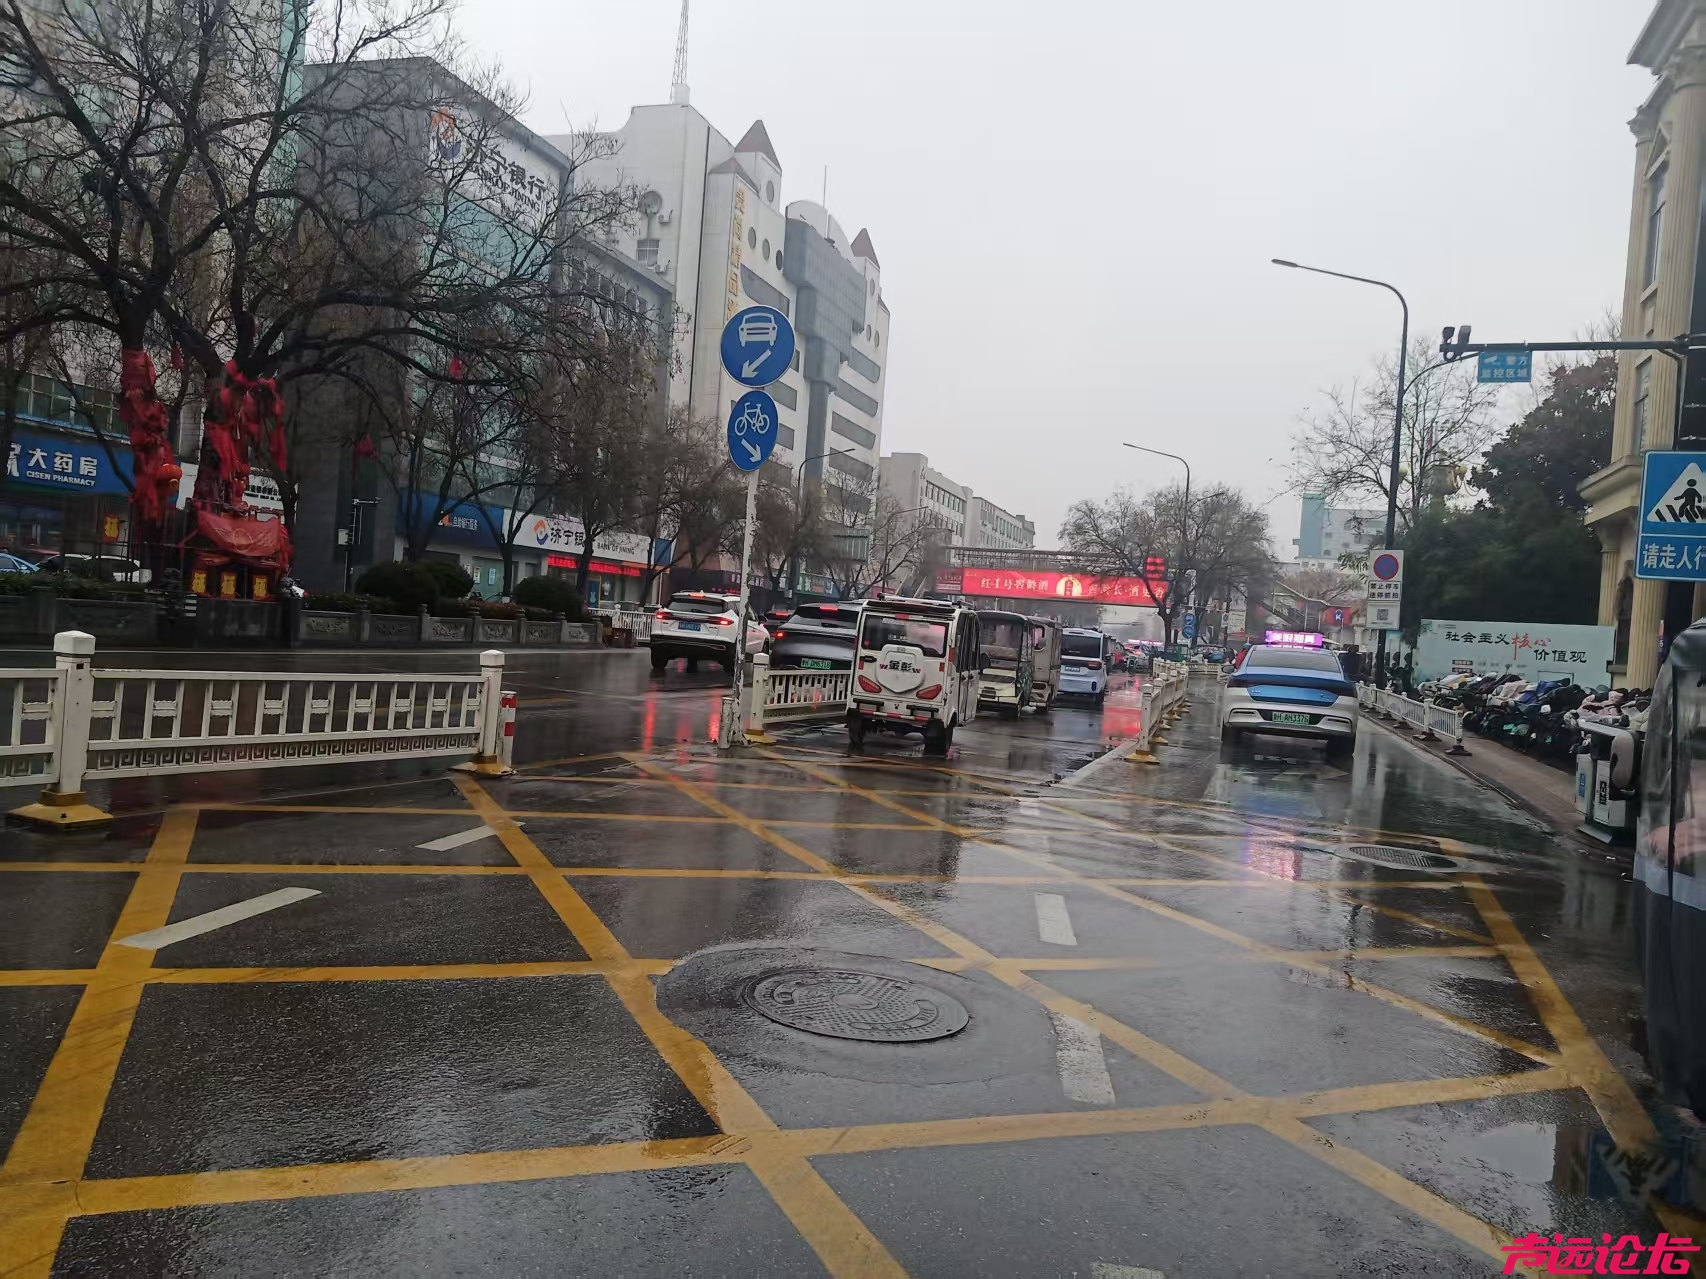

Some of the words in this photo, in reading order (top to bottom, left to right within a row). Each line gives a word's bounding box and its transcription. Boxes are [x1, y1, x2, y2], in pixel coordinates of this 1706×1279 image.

[1481, 367, 1528, 379] 监控区域
[26, 470, 51, 481] CISEN
[52, 474, 96, 487] PHARMACY
[1369, 582, 1399, 590] 禁止停车
[1369, 591, 1399, 599] 违停抓拍
[1533, 649, 1587, 663] 价值观
[888, 659, 913, 673] 金彭
